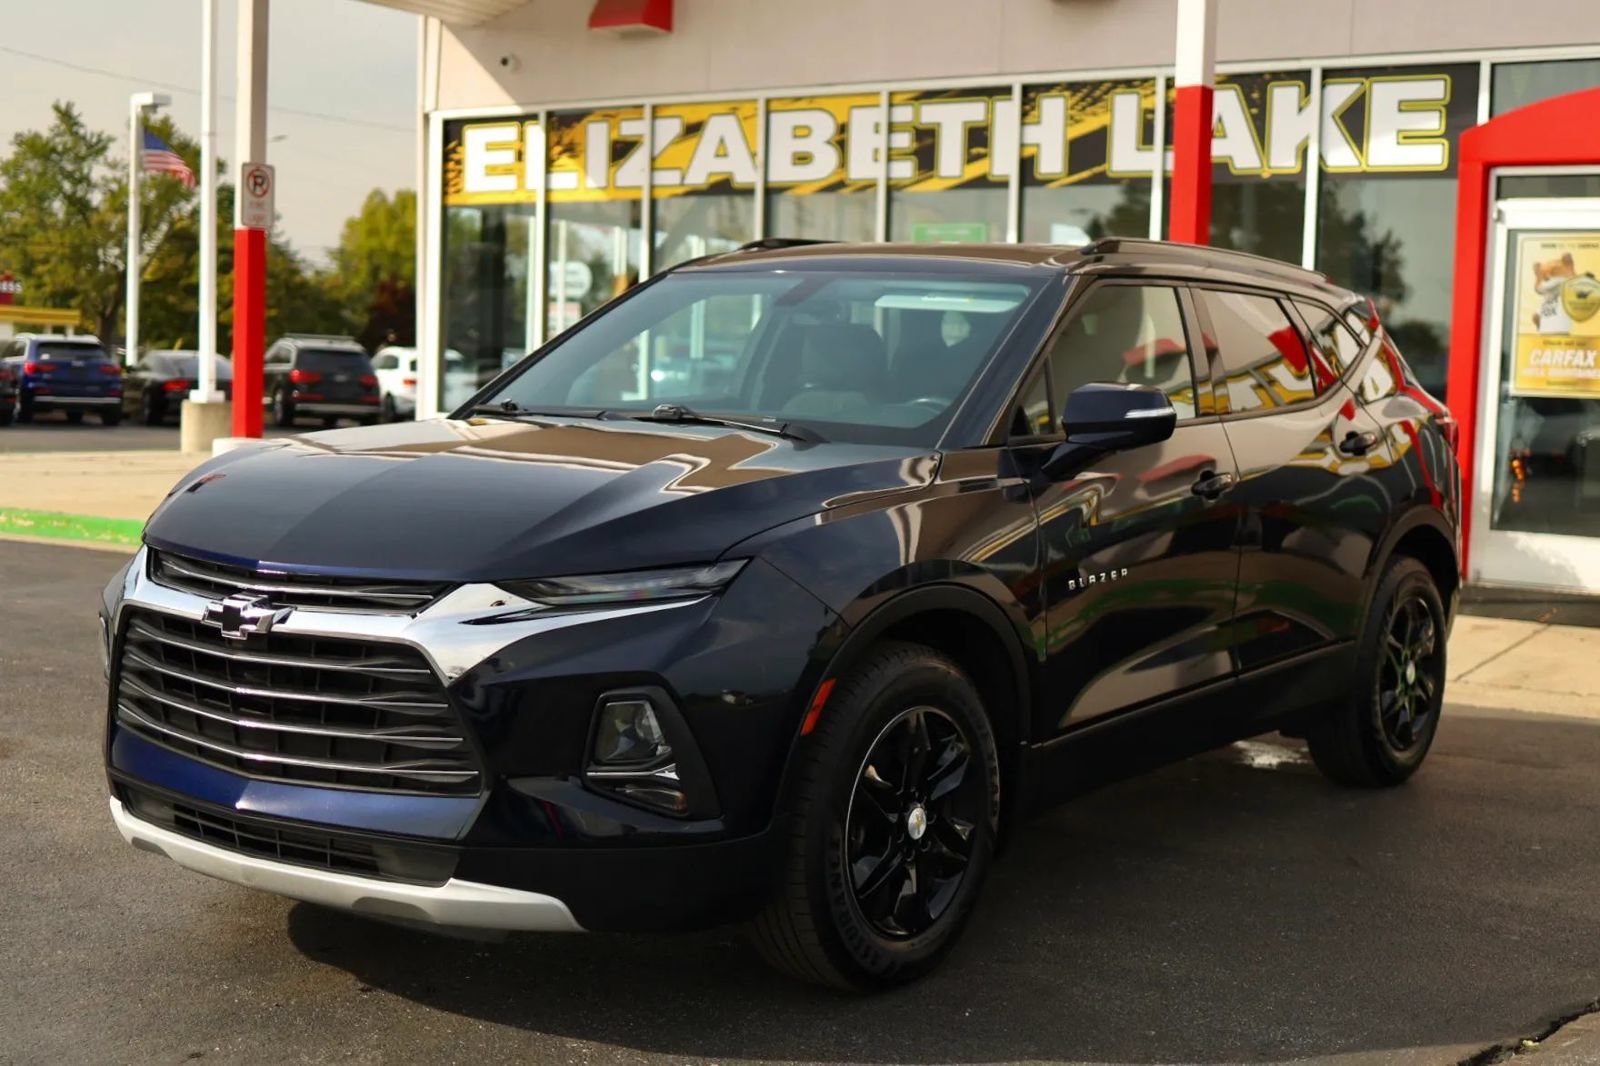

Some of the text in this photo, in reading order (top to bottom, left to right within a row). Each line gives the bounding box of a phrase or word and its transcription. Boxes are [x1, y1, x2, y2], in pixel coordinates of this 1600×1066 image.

[463, 75, 1450, 192] ELIZABETH LAKE
[1530, 349, 1597, 368] CARFAX
[1067, 567, 1128, 590] BLAZER
